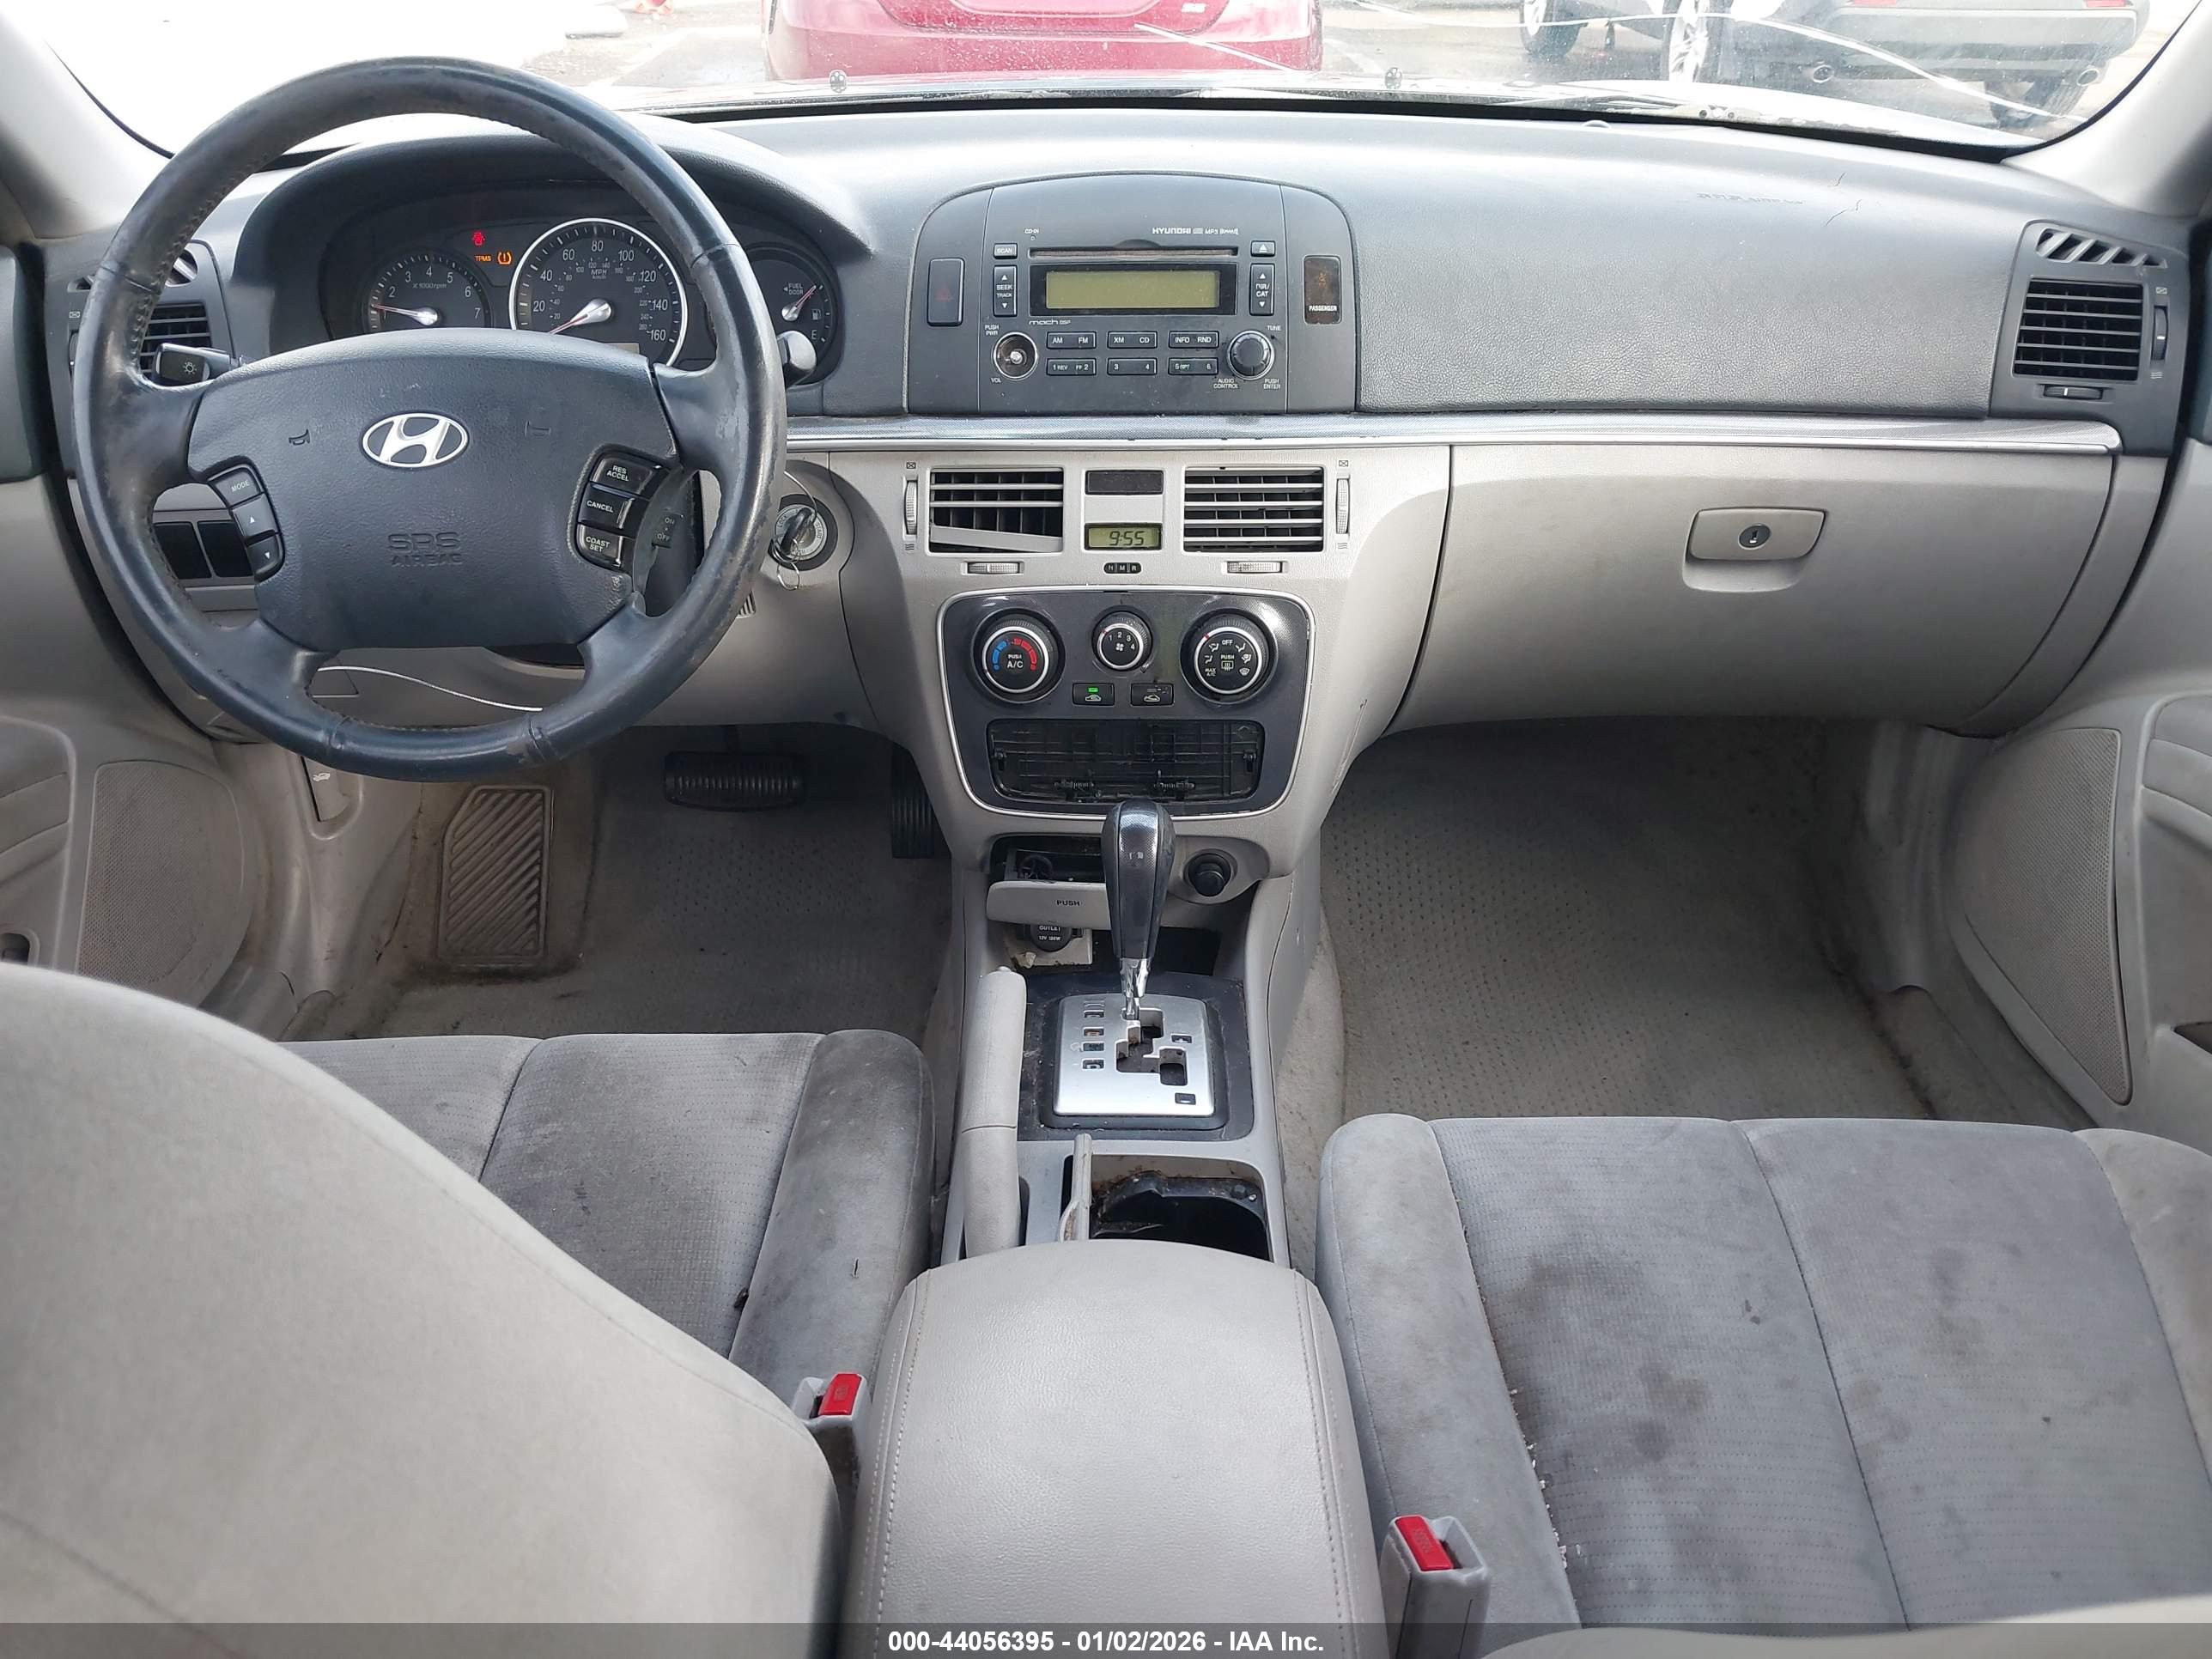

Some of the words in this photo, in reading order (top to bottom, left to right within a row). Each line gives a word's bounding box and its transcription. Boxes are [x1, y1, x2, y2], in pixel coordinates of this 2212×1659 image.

[591, 240, 604, 252] 80
[562, 248, 575, 260] 60
[618, 250, 635, 261] 100
[404, 271, 411, 283] 3
[426, 265, 432, 277] 4
[447, 271, 453, 283] 5
[540, 270, 553, 282] 40
[641, 270, 656, 282] 120
[389, 286, 396, 298] 2
[465, 286, 471, 297] 6
[533, 301, 545, 312] 20
[652, 299, 668, 310] 140
[475, 307, 480, 319] 7
[649, 329, 666, 340] 160
[811, 330, 817, 340] E
[612, 465, 628, 475] RES
[606, 471, 629, 482] ACCEL
[230, 479, 250, 493] MODE
[586, 500, 614, 514] CANCEL
[657, 532, 670, 541] OFF
[814, 522, 823, 539] START
[387, 532, 461, 553] SRS
[585, 536, 611, 548] COAST
[1109, 531, 1146, 546] 9:55
[589, 544, 604, 552] SET
[391, 552, 464, 568] AIRBAG
[1006, 660, 1024, 669] A/C
